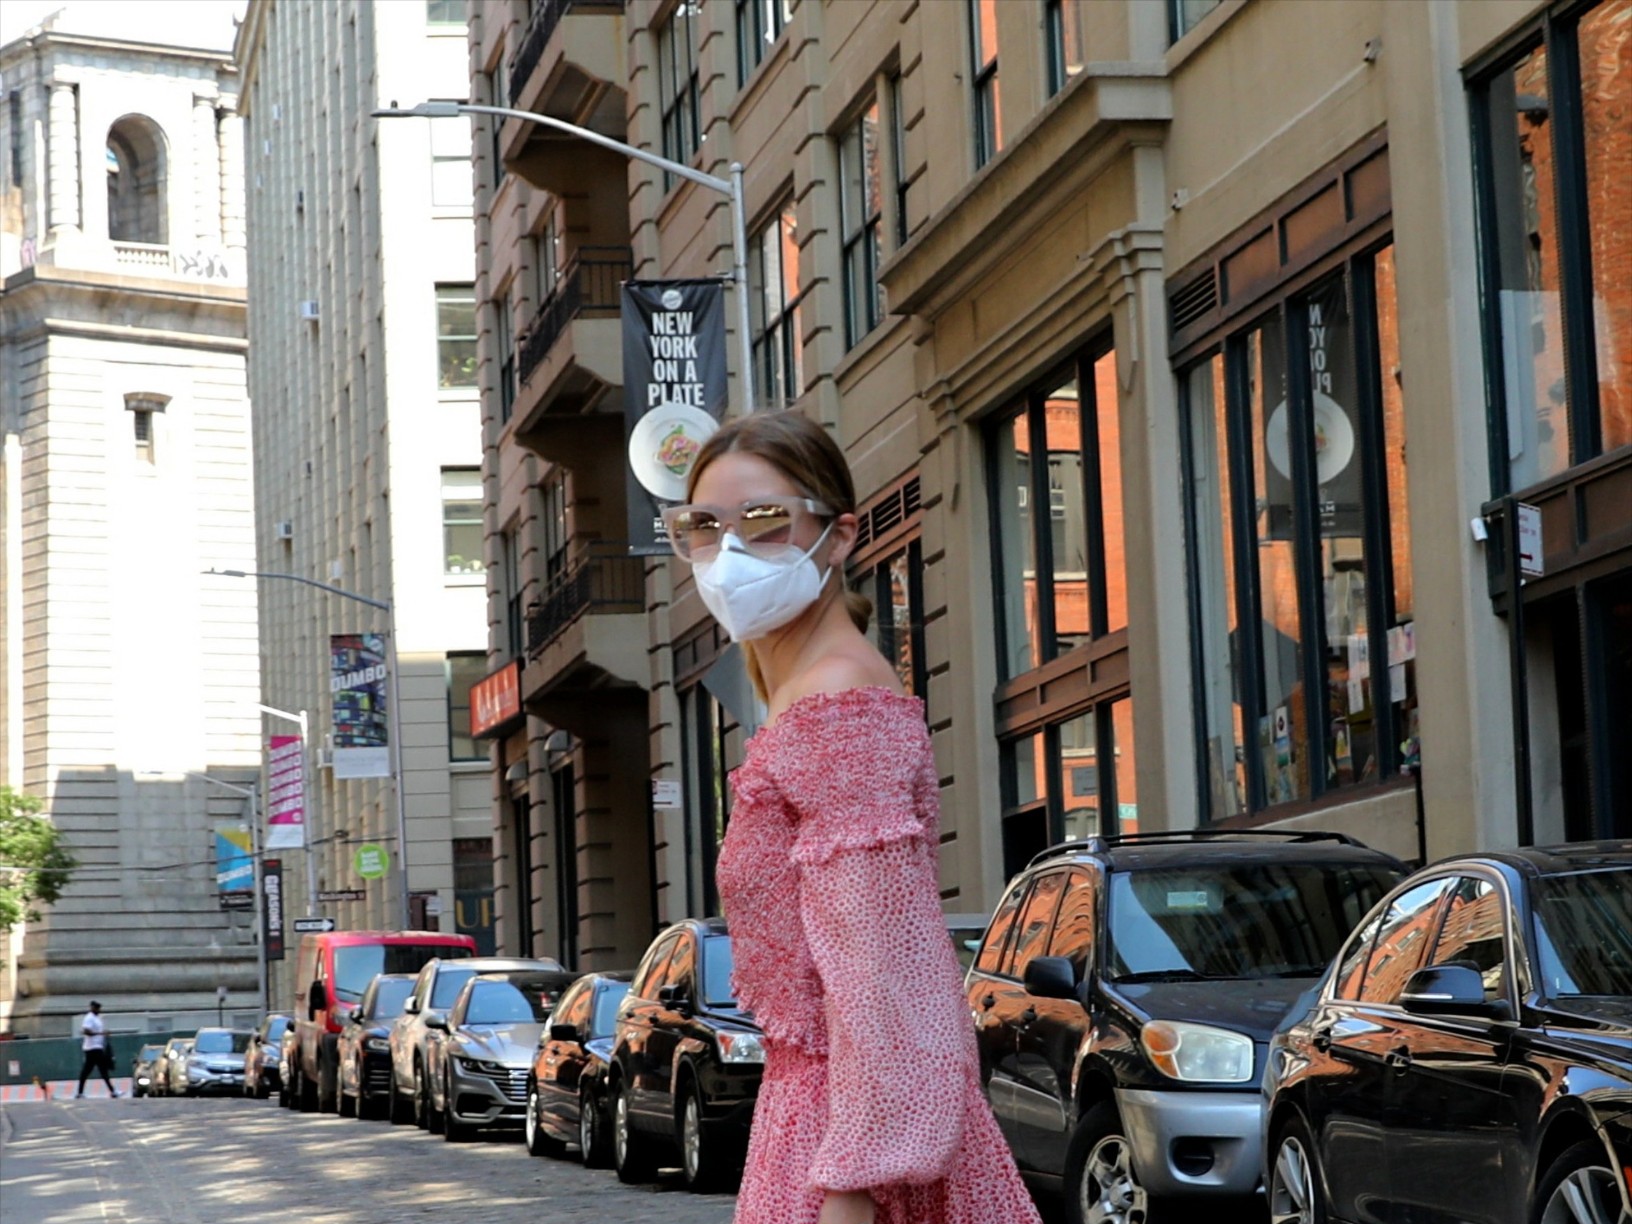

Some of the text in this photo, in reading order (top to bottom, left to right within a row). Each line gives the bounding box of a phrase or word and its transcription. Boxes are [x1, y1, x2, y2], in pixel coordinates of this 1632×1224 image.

[652, 311, 693, 335] NEW
[650, 335, 698, 359] YORK
[653, 359, 698, 382] ON A
[648, 383, 705, 406] PLATE
[330, 664, 387, 693] DUMBO
